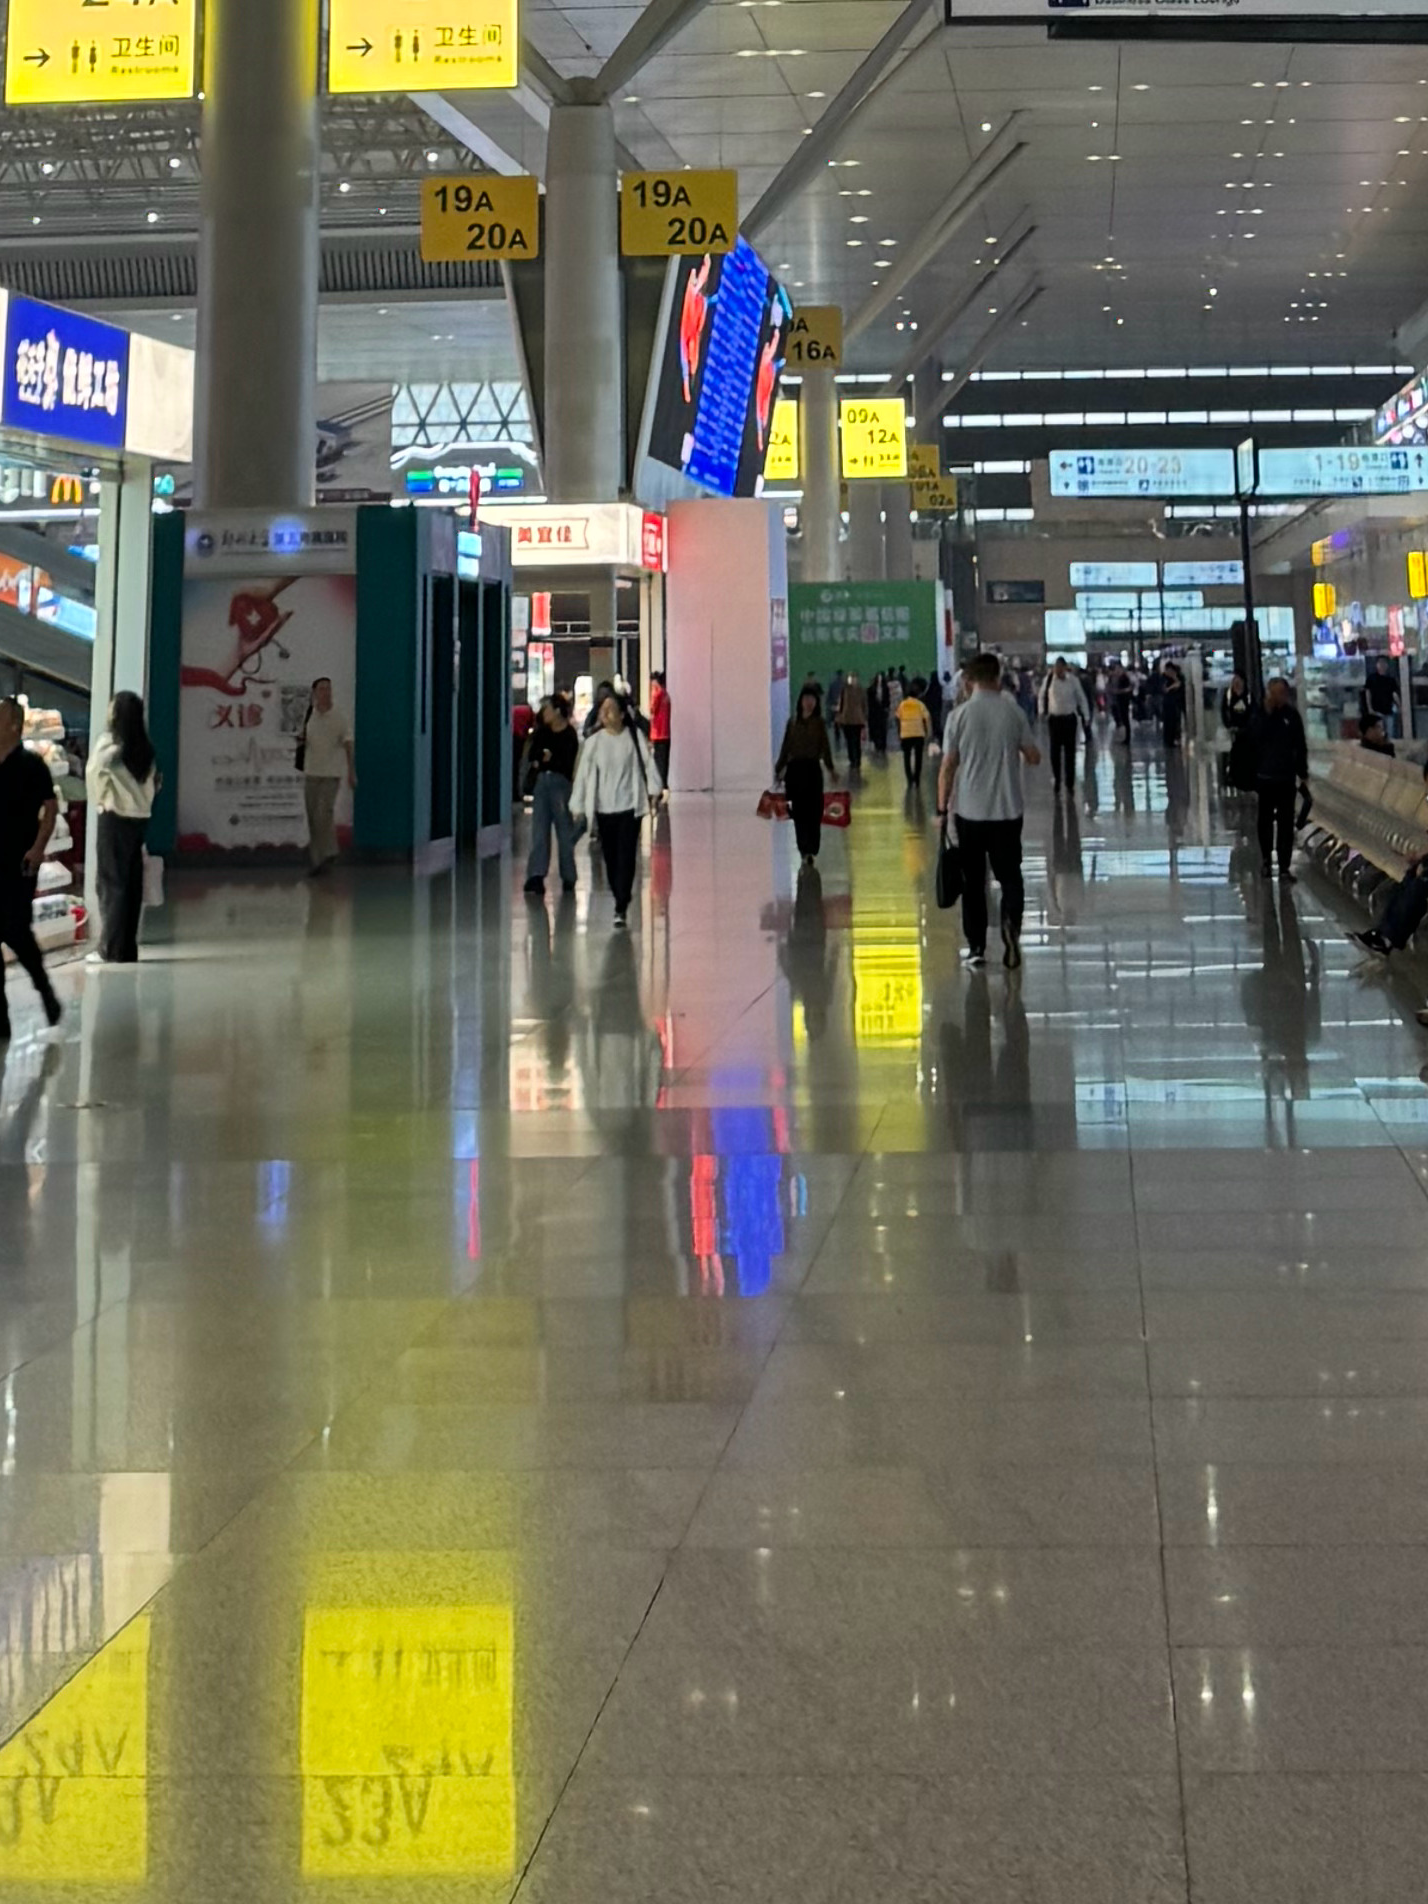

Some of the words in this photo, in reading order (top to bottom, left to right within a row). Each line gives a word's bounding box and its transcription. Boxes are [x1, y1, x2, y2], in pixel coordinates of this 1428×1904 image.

[111, 34, 180, 58] 卫生间
[433, 24, 503, 48] 卫生间
[434, 185, 494, 212] 19A
[633, 180, 691, 208] 19A
[466, 223, 528, 250] 20A
[668, 217, 728, 245] 20A
[793, 340, 837, 361] 16A
[847, 408, 880, 424] 09A
[868, 429, 900, 445] 12A
